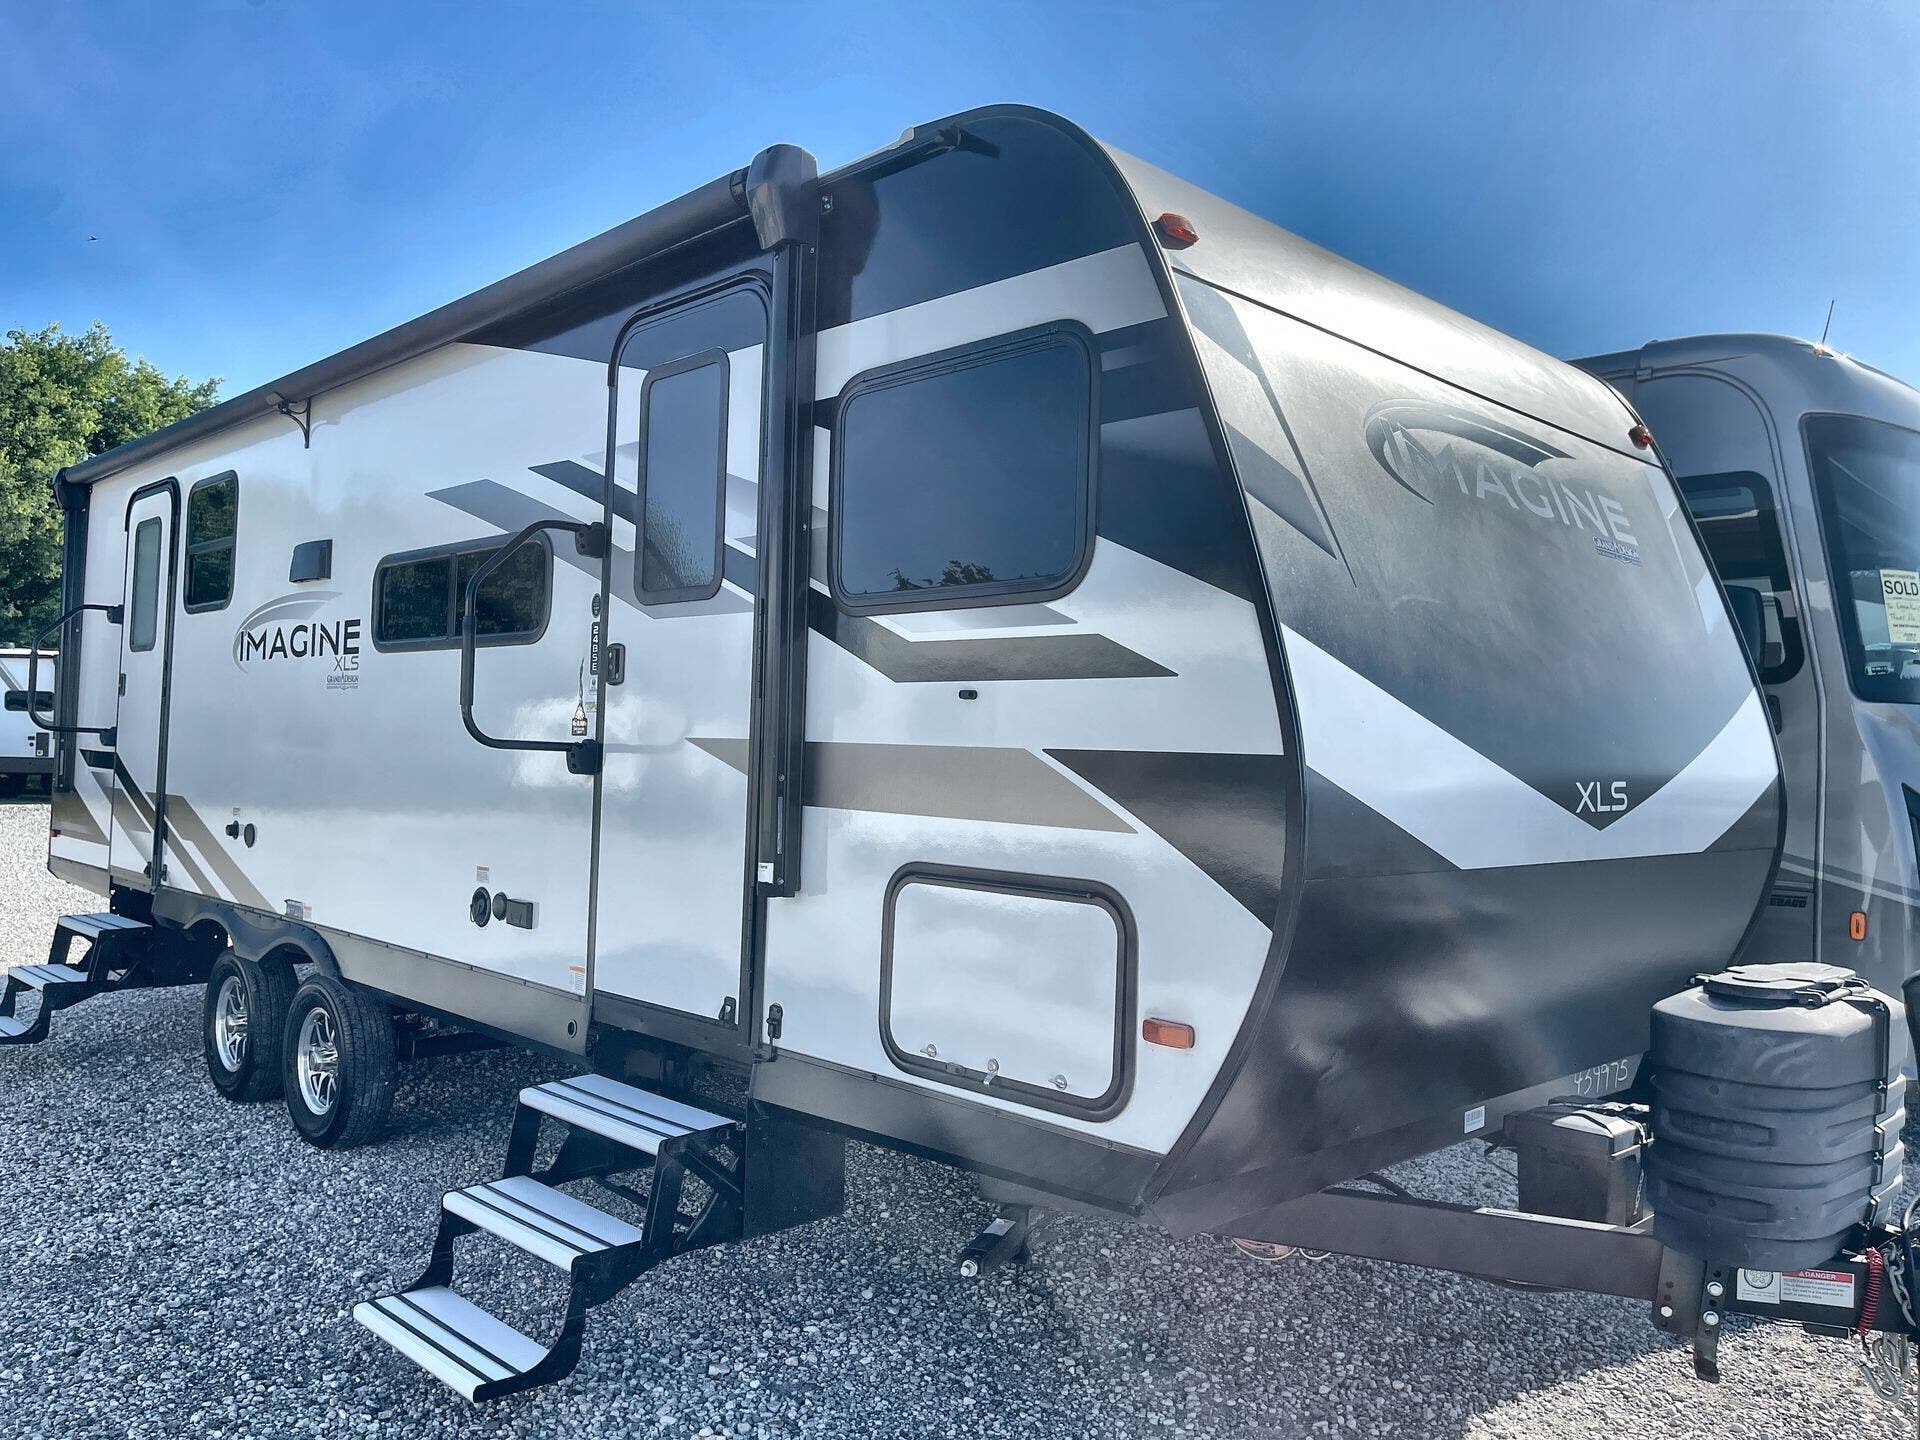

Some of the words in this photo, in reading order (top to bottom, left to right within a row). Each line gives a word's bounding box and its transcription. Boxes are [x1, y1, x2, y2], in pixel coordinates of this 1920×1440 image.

[1379, 416, 1639, 547] IMAGINE
[1883, 580, 1919, 596] SOLD
[240, 619, 360, 661] IMAGINE
[333, 655, 359, 671] XLS
[1575, 781, 1628, 813] XLS
[1805, 1271, 1836, 1280] DANGER
